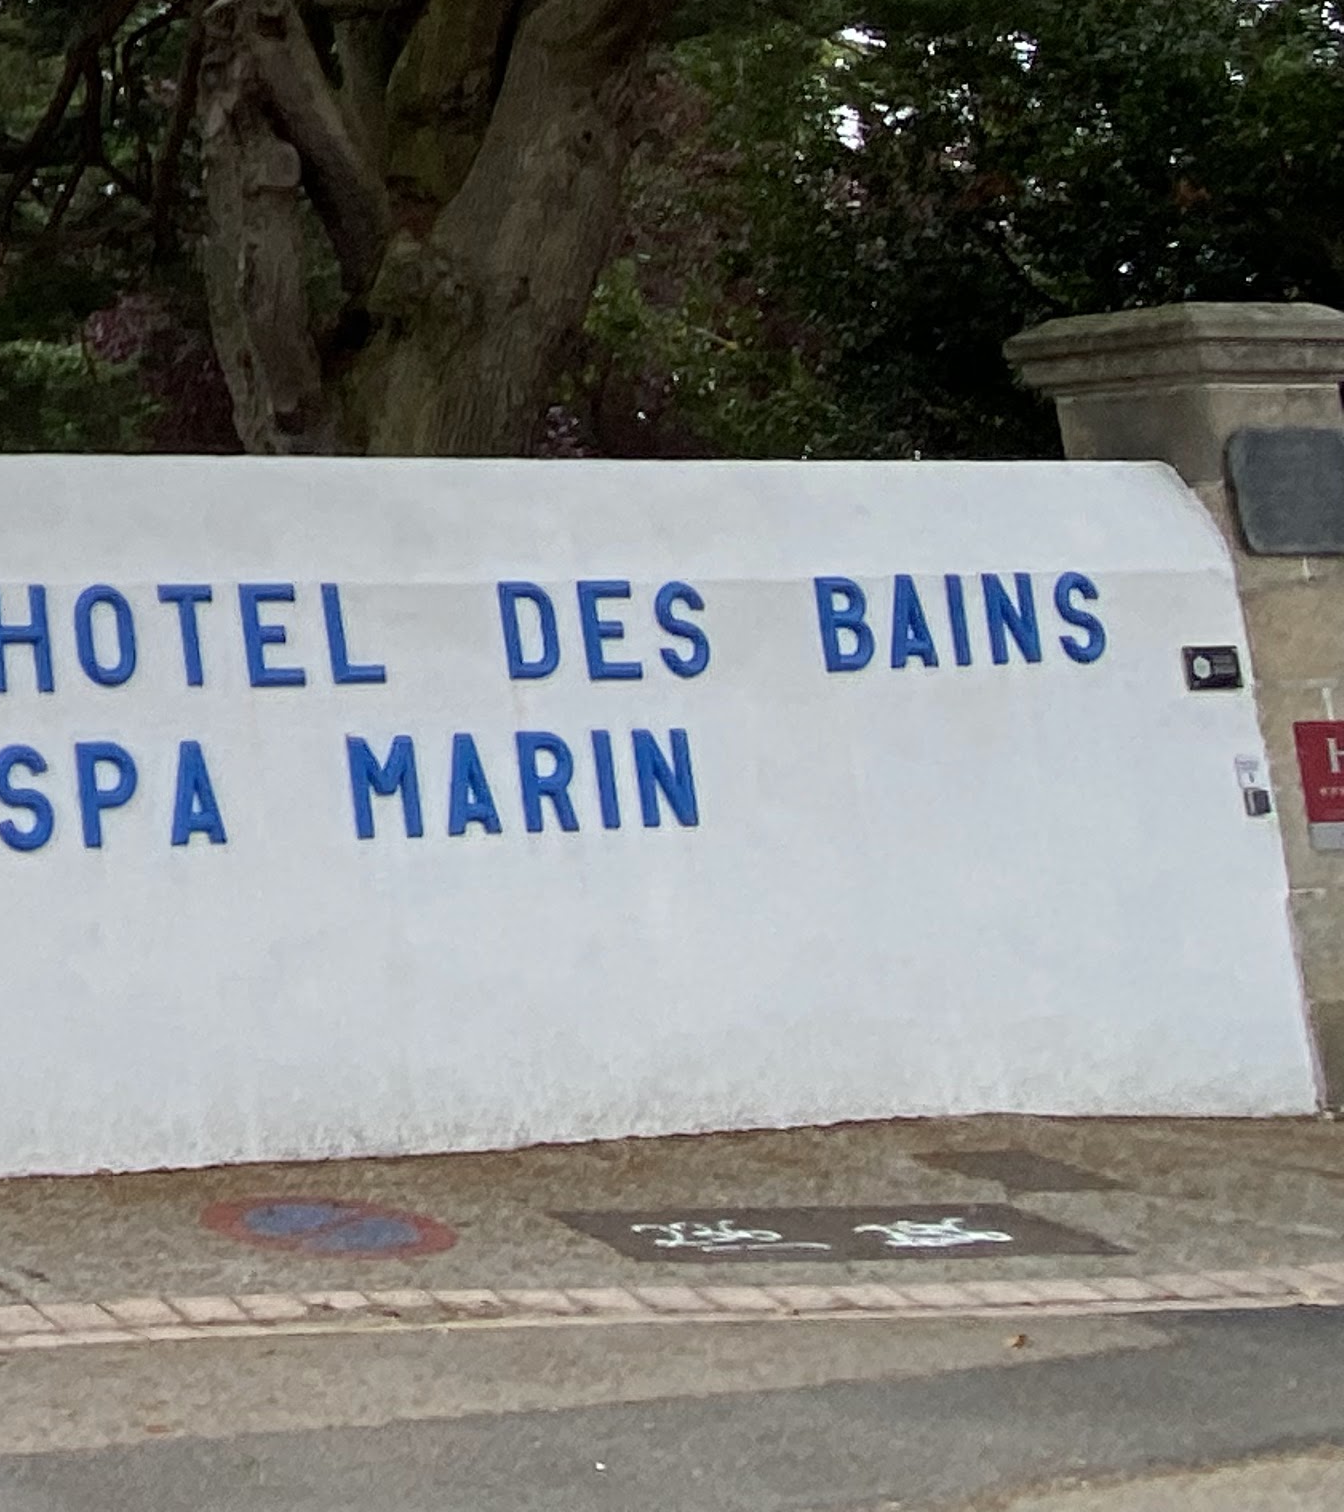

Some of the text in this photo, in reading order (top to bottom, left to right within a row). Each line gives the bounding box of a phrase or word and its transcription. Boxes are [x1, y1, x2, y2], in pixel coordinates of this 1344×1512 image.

[498, 580, 710, 680] DES
[814, 572, 1105, 672] BAINS
[347, 728, 698, 839] MARIN
